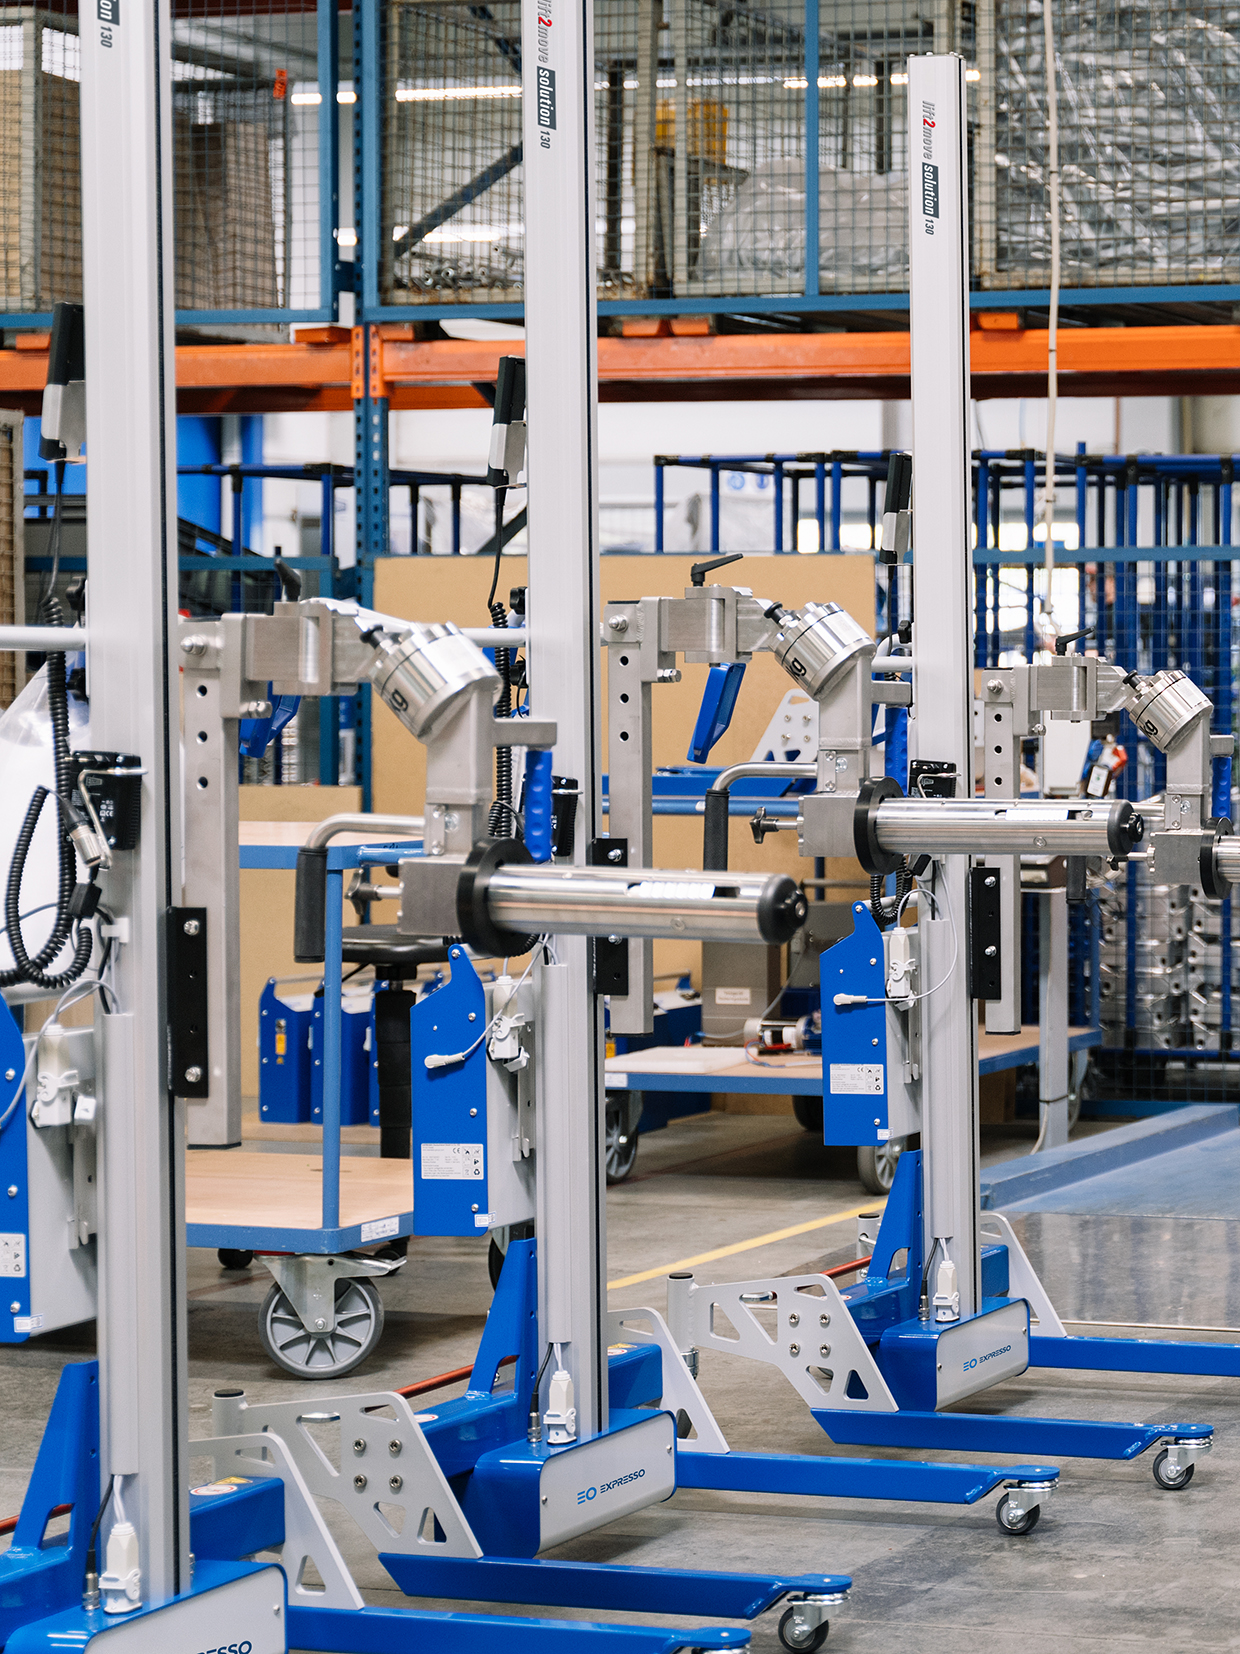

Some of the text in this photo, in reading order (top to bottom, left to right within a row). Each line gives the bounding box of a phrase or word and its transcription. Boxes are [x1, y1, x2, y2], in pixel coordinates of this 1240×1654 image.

[100, 26, 113, 49] 130
[538, 67, 554, 127] solution
[540, 130, 551, 149] 130
[922, 100, 938, 236] lift2move solution 130
[979, 1344, 1012, 1364] EXPRESSO
[600, 1468, 646, 1494] EXPRESSO
